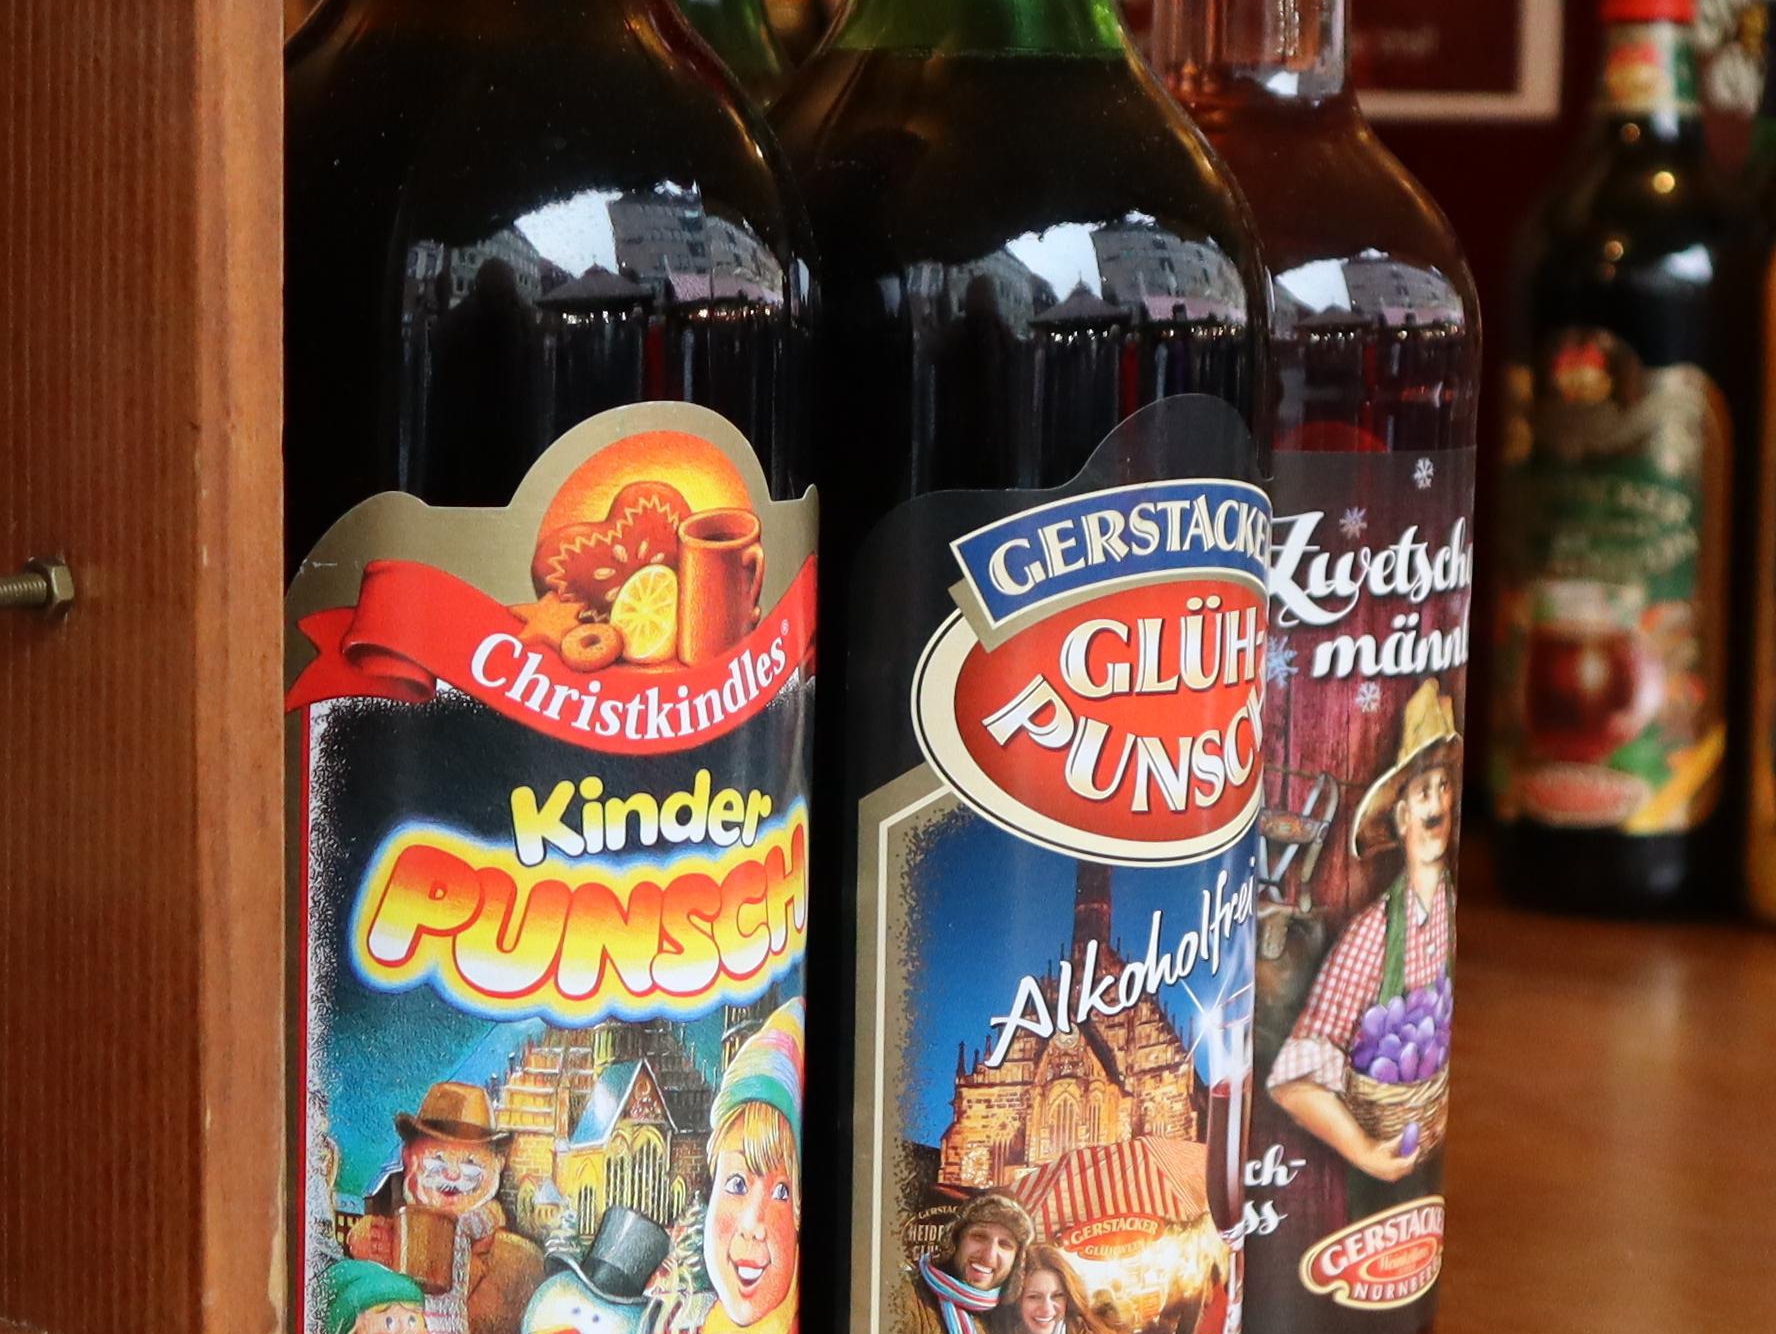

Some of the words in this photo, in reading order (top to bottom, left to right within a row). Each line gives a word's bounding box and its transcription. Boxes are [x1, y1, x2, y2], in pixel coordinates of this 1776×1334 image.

[989, 494, 1271, 595] GERSTACKE
[470, 632, 786, 742] Christkindles
[1060, 595, 1265, 699] GLÜH-
[509, 769, 773, 866] Kinder
[367, 823, 806, 998] PUNSCH
[984, 856, 1256, 1068] Alkoholfrei
[1071, 1218, 1159, 1245] GERSTACKER
